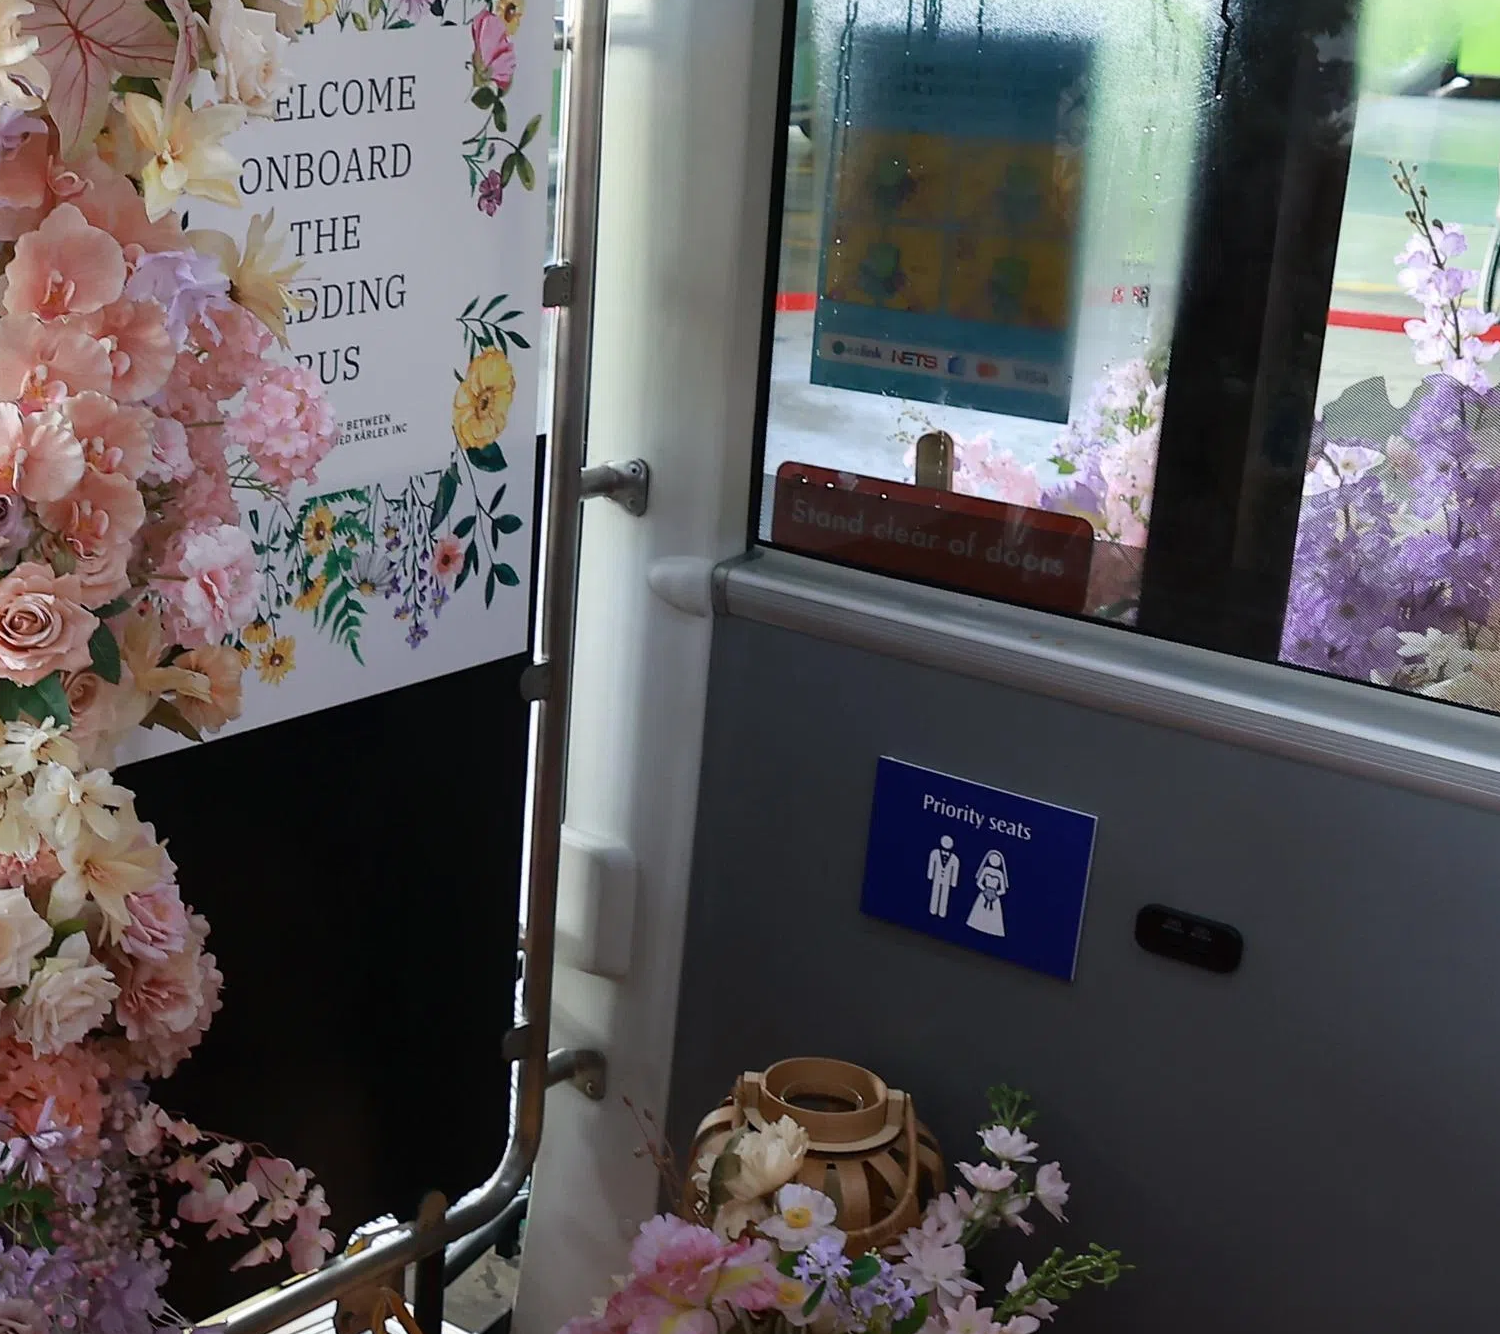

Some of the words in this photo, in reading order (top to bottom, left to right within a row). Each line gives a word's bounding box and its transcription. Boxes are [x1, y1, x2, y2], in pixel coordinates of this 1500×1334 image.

[246, 75, 416, 122] ELCOME
[239, 143, 412, 195] ONBOARD
[290, 214, 361, 257] THE
[891, 349, 939, 370] NETS
[346, 413, 391, 431] BETWEEN
[791, 499, 864, 535] Stand
[873, 514, 940, 550] clear
[949, 527, 976, 556] of
[923, 794, 985, 829] Priority
[988, 817, 1031, 840] seats
